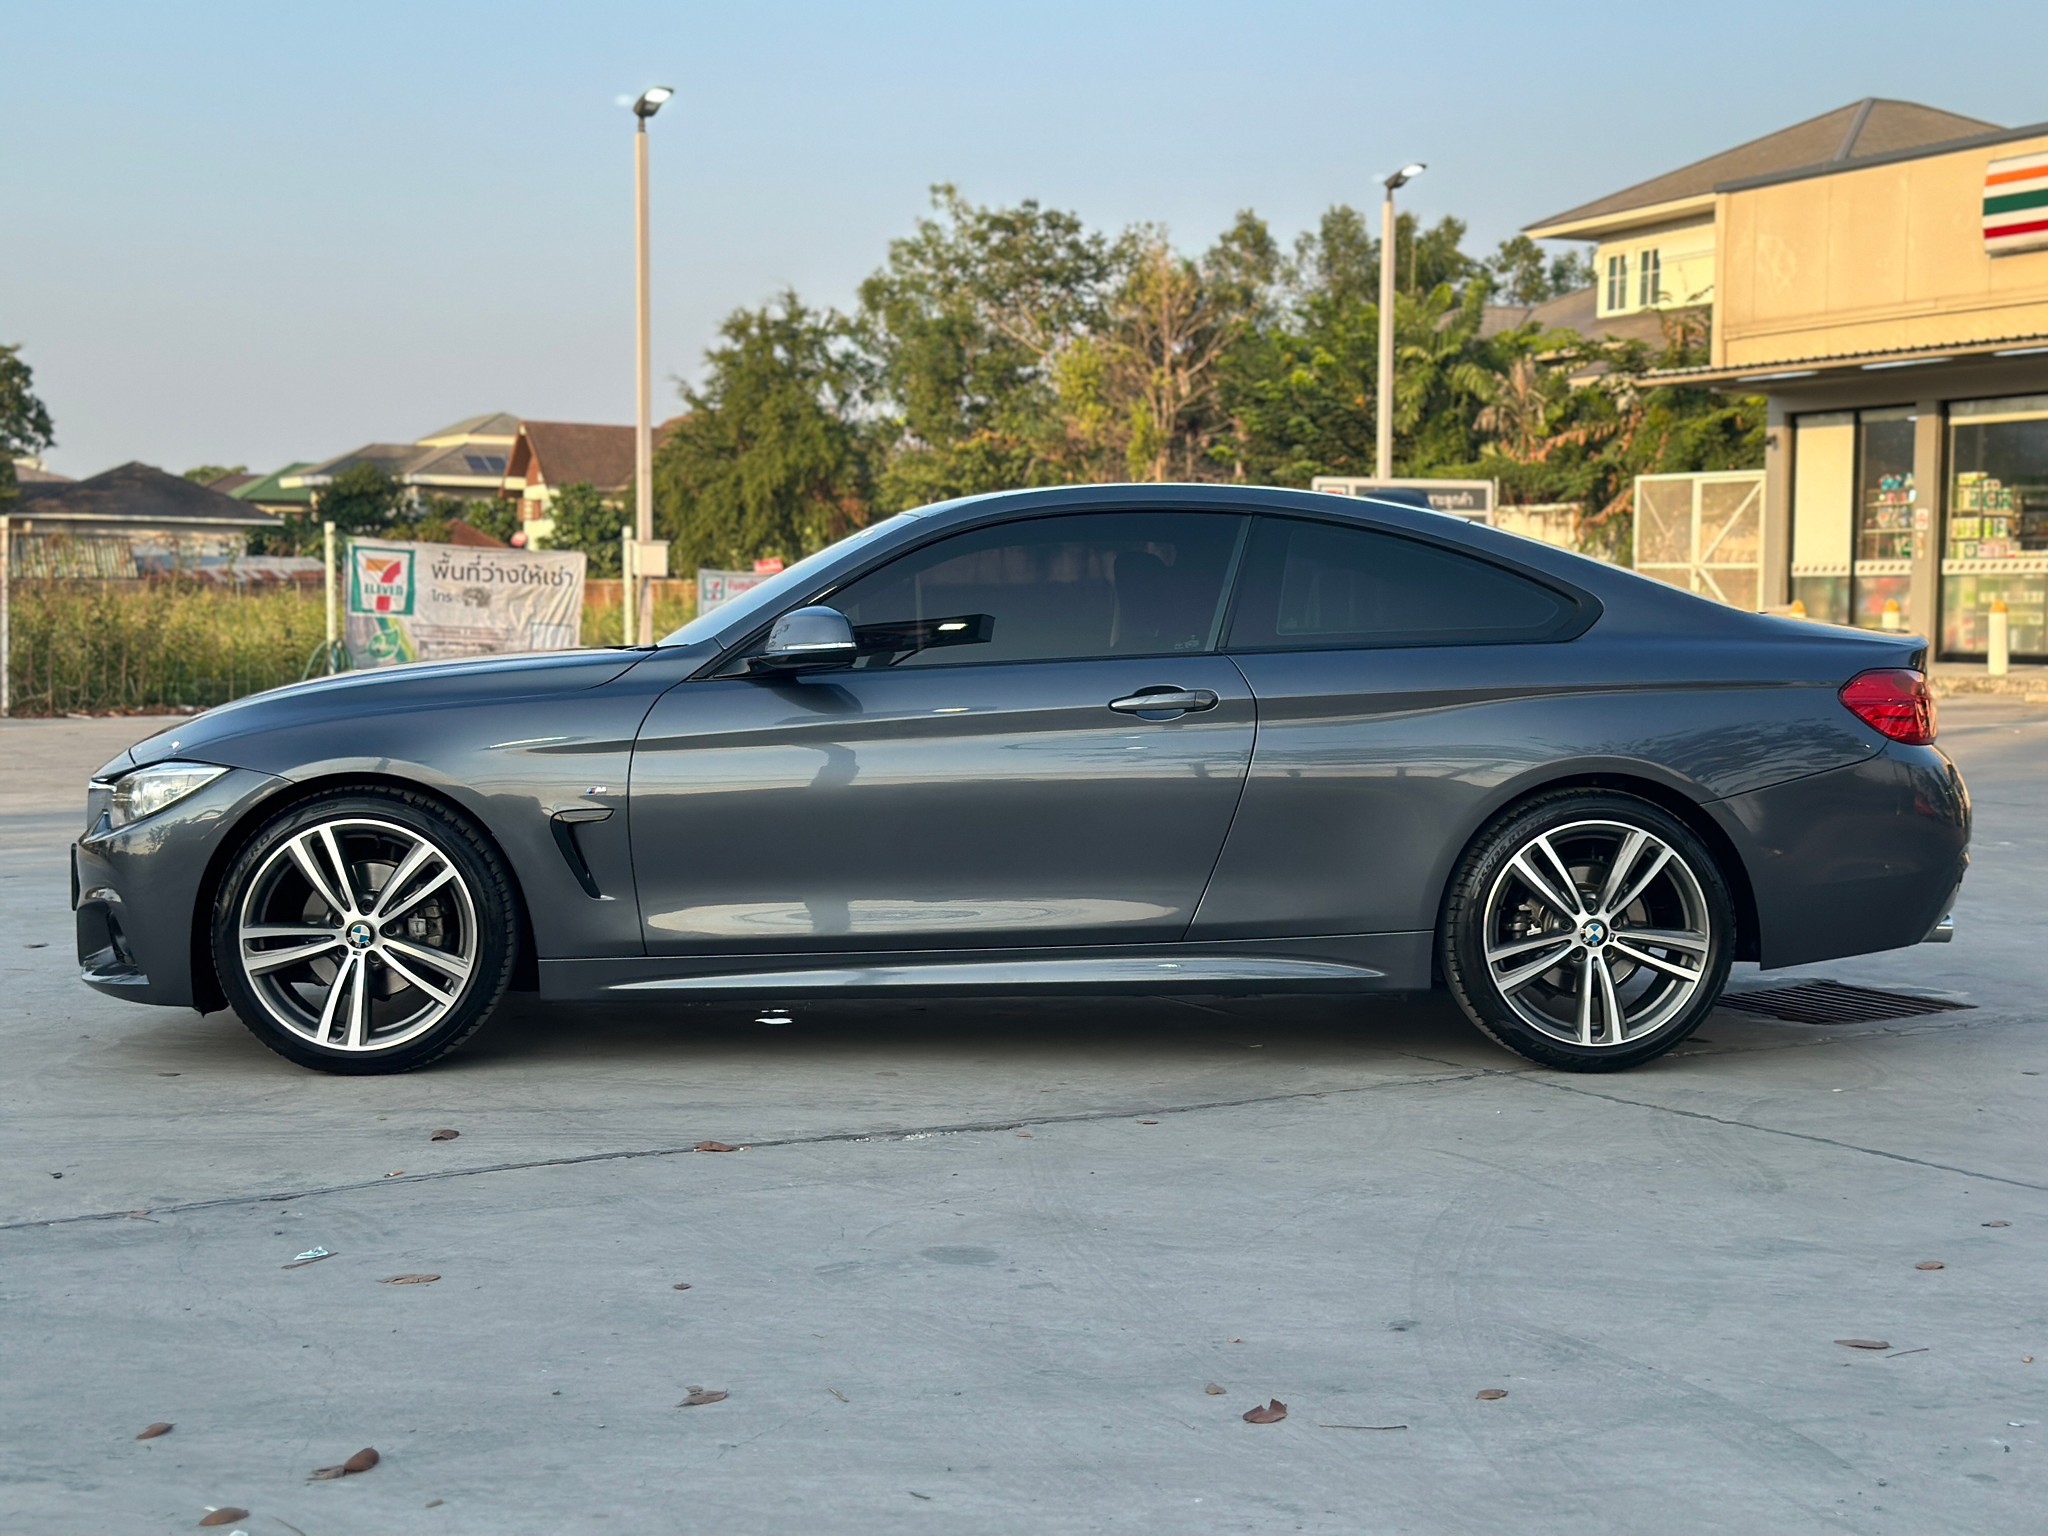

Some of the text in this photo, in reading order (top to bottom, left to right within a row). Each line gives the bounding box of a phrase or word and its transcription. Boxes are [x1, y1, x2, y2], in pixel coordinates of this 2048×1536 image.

[431, 552, 574, 587] พื้นที่ว่างให้เช่า
